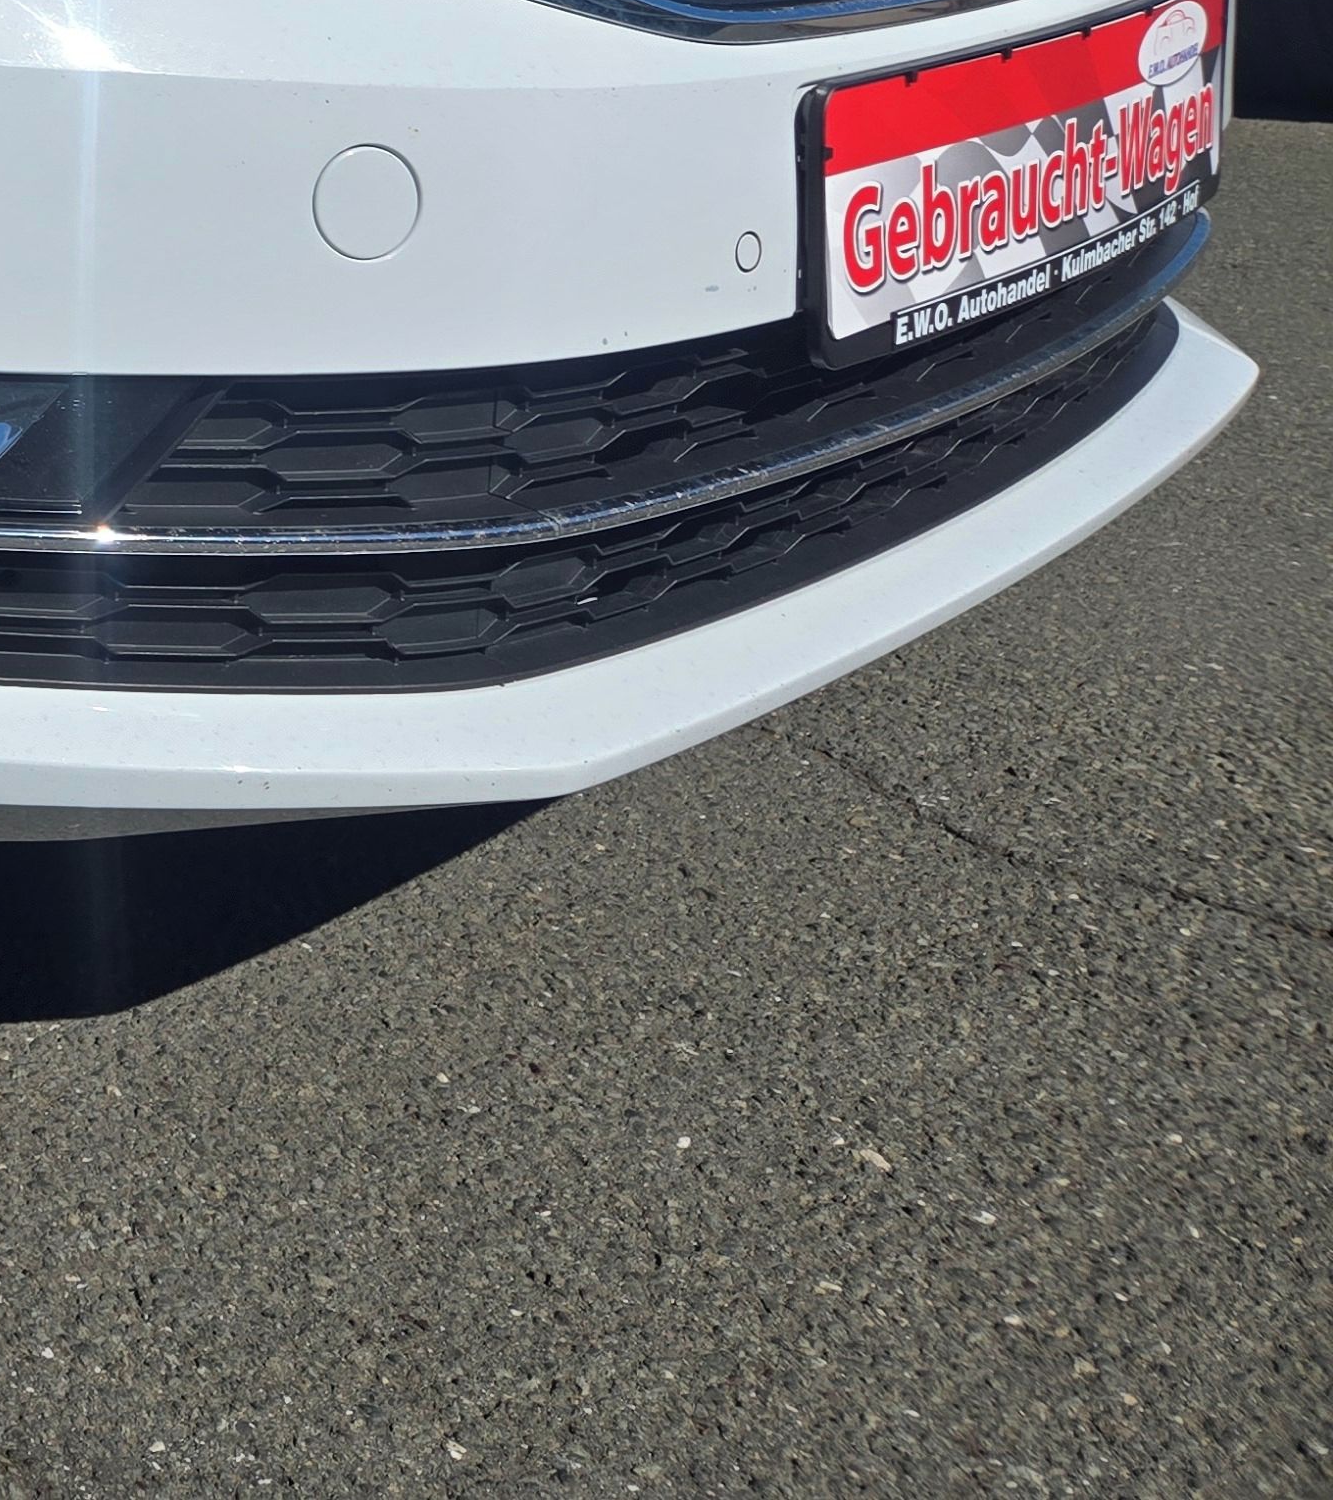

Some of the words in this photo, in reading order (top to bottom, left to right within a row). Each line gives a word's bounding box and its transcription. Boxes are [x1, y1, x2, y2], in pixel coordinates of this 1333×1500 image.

[843, 83, 1214, 292] Gebraucht-Wagen
[896, 303, 952, 345] E.W.O.
[958, 269, 1050, 323] Autohandel
[1061, 228, 1137, 282] Kulmbacher
[1139, 217, 1157, 243] Str.
[1159, 200, 1176, 230] 142
[1182, 186, 1199, 216] Hof
